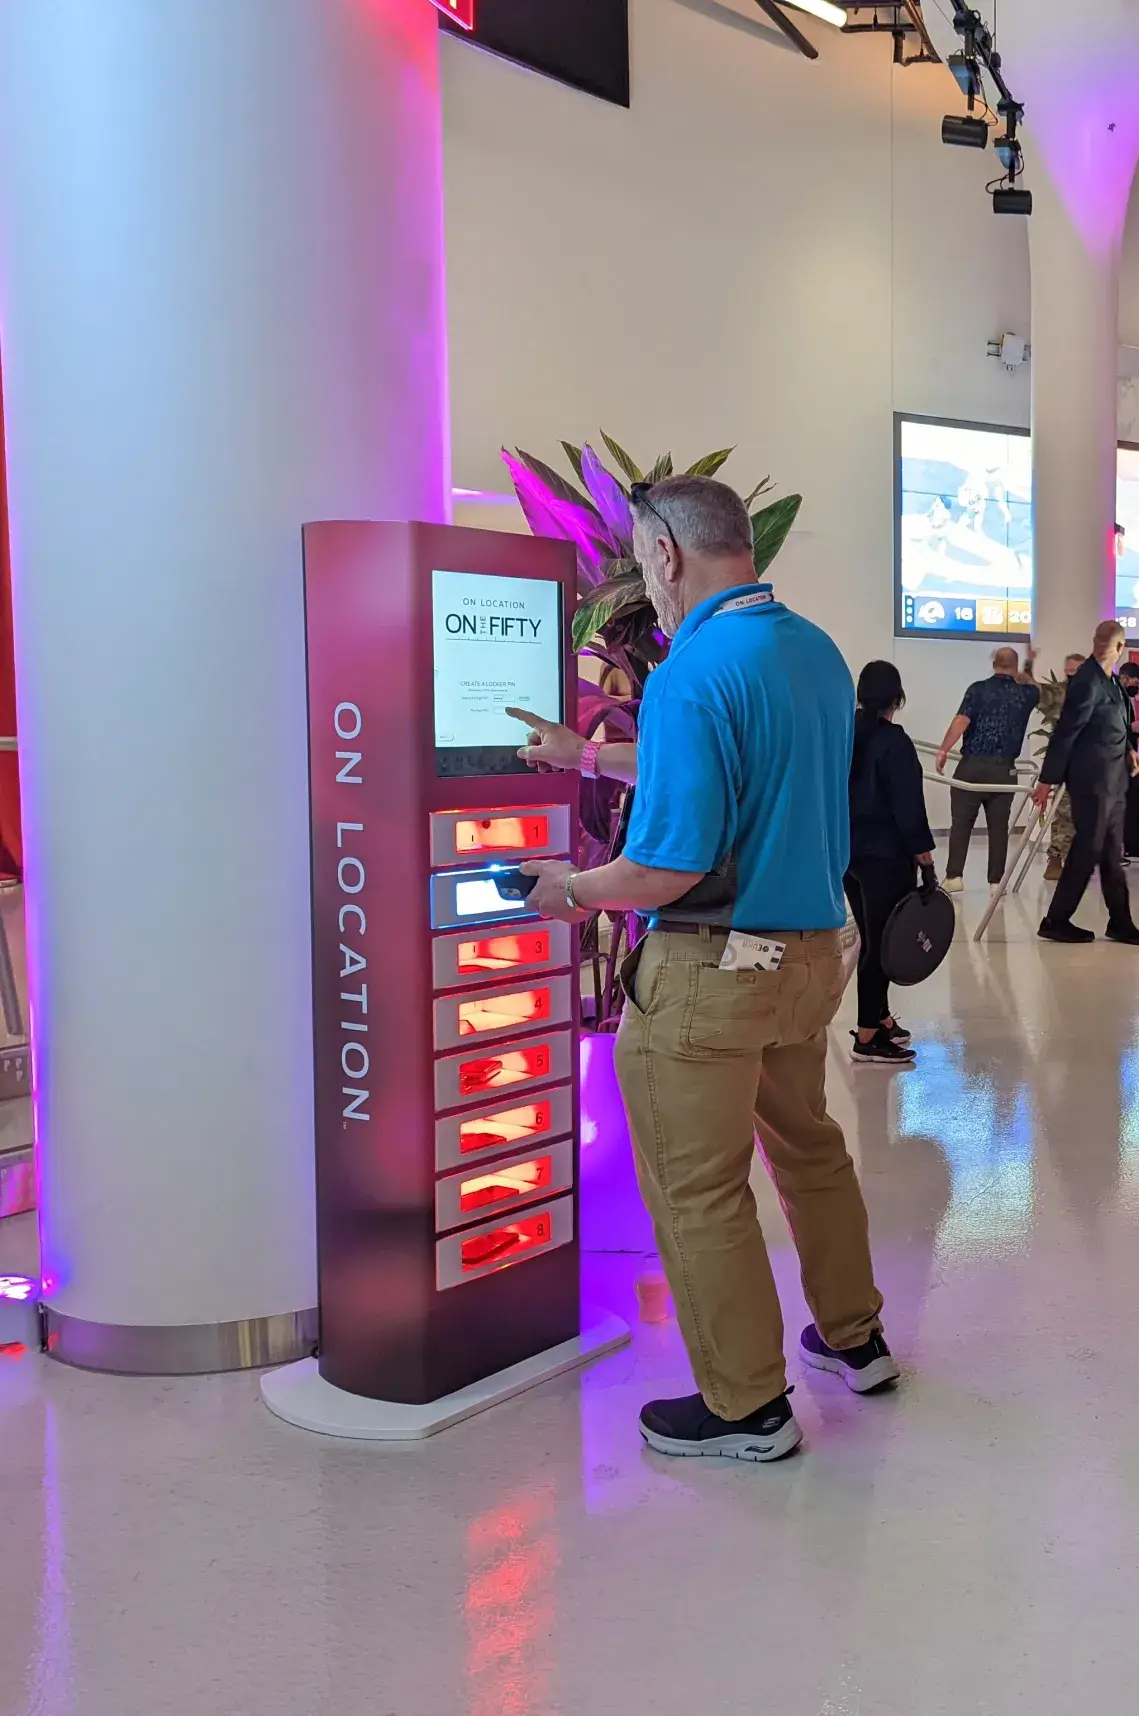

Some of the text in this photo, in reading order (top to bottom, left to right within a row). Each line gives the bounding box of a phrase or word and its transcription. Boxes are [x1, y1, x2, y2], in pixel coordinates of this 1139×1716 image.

[462, 597, 525, 609] ON LOCATION
[445, 613, 477, 634] ON
[489, 616, 542, 637] FIFTY
[333, 701, 363, 784] ON
[533, 825, 540, 838] 1
[534, 940, 543, 954] 3
[336, 821, 371, 1122] LOCATION
[534, 997, 543, 1010] 4
[536, 1054, 544, 1067] 5
[535, 1111, 543, 1125] 6
[536, 1166, 544, 1180] 7
[536, 1222, 544, 1236] 8
